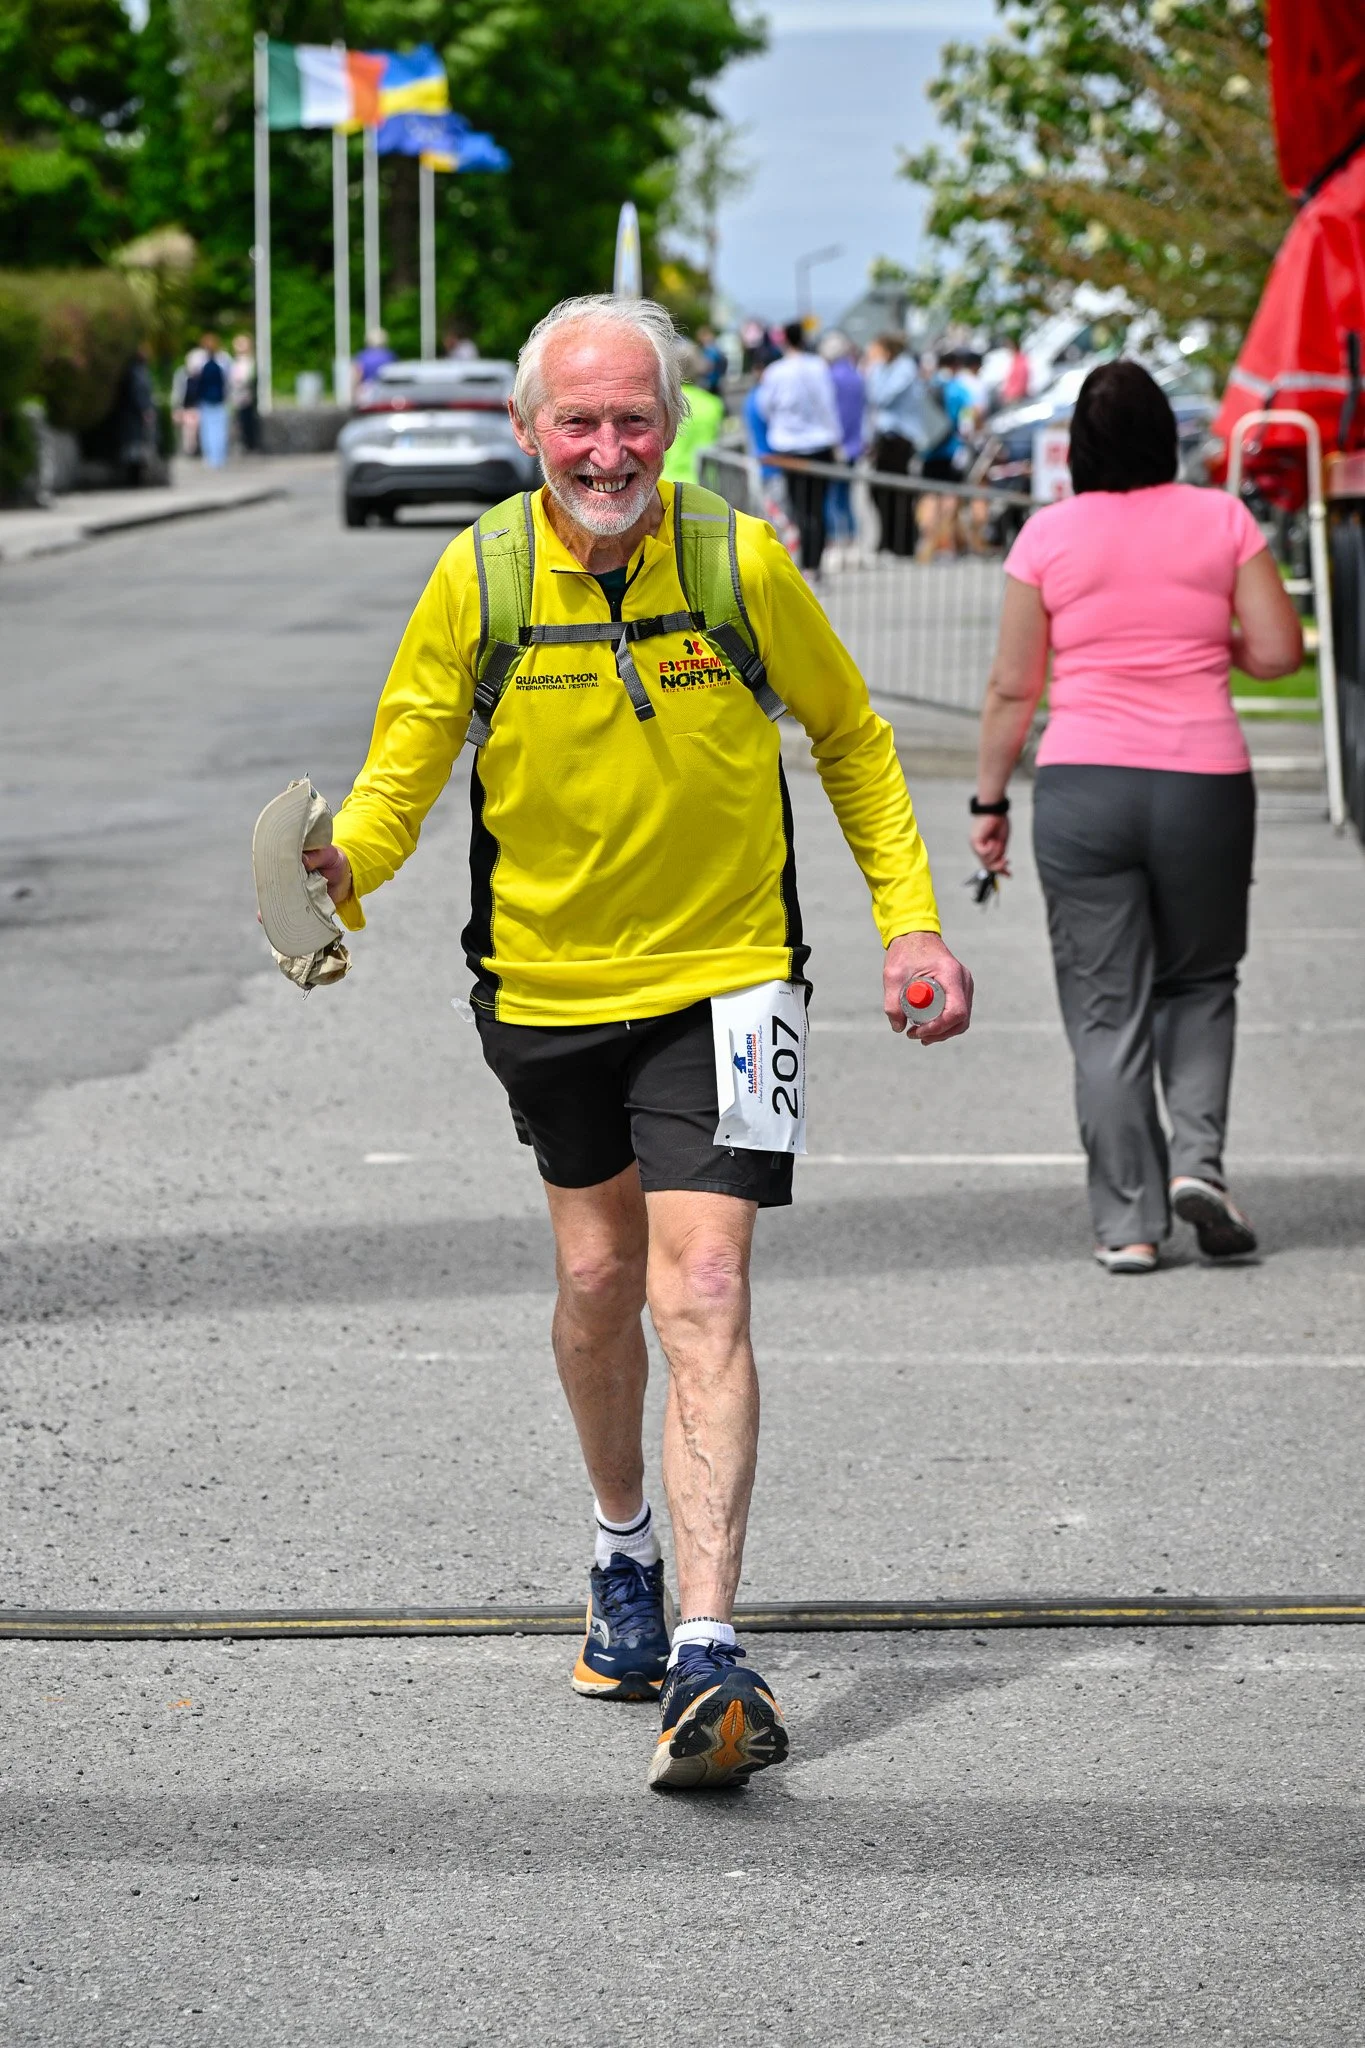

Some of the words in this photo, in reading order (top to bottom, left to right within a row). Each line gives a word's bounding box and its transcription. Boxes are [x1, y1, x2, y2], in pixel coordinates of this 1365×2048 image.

[659, 656, 724, 673] EXTREM
[515, 672, 598, 685] QUADRATHON
[568, 682, 600, 690] FESTIVAL
[660, 668, 731, 689] NORTH
[746, 1033, 754, 1067] BURREN
[772, 1015, 799, 1120] 207
